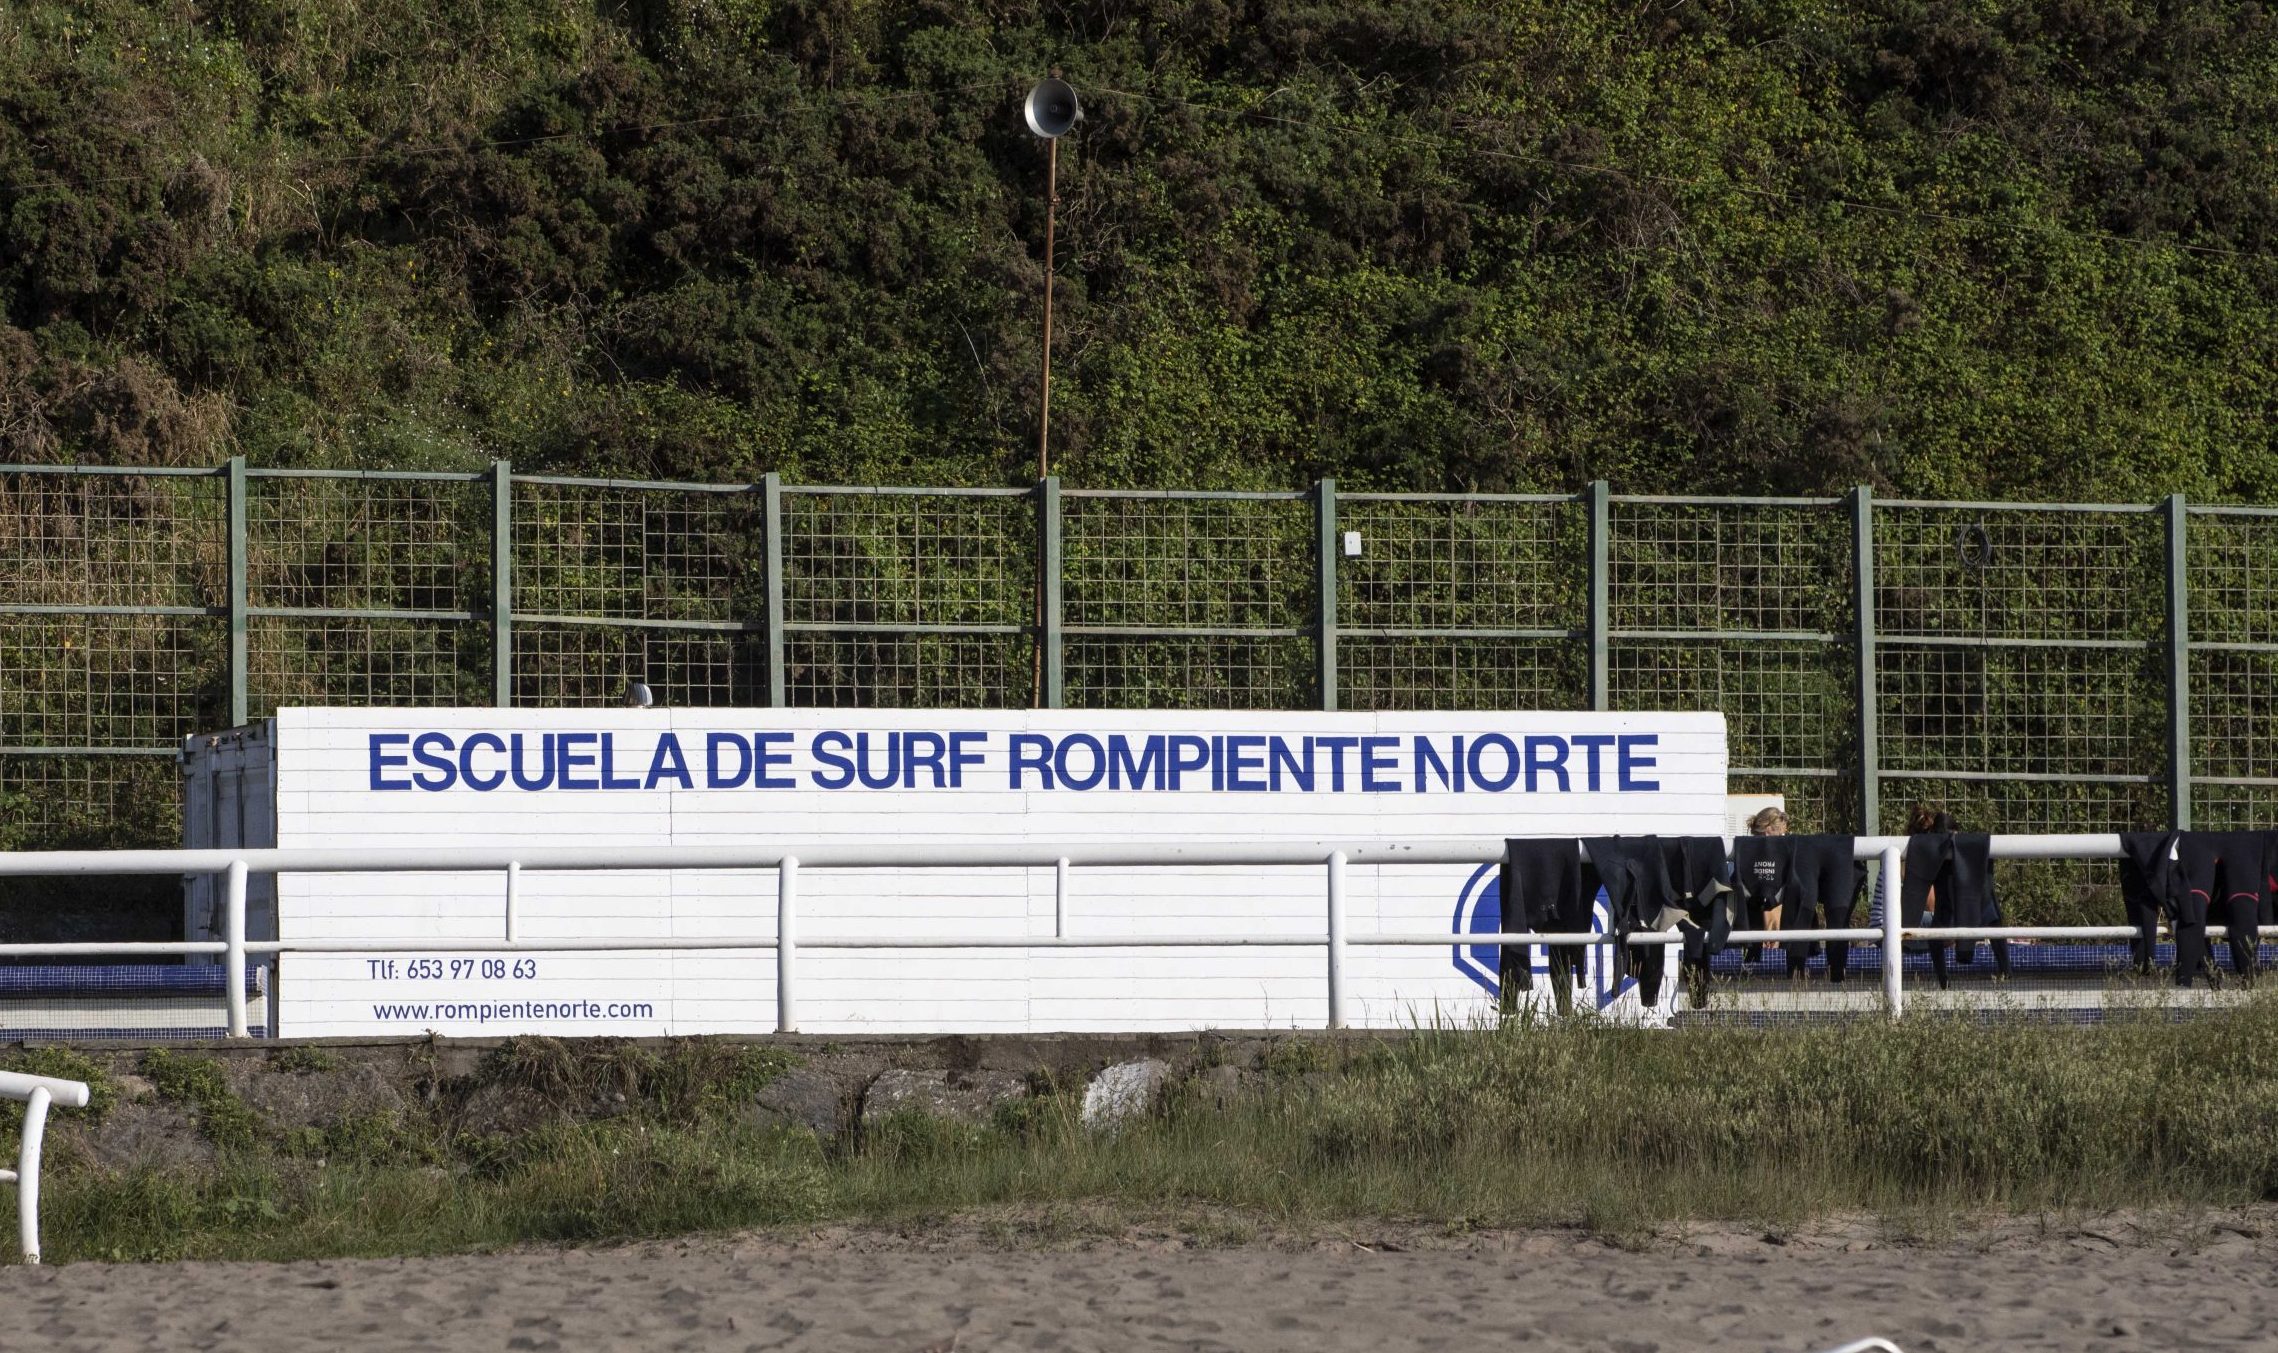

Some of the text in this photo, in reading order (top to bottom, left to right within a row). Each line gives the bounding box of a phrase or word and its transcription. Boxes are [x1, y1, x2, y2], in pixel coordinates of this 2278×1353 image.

[368, 731, 1660, 792] ESCUELA DE SURF ROMPIENTE NORTE
[366, 958, 537, 980] Tlf: 653 97 08 63
[373, 999, 653, 1024] www.rompientenorte.com
